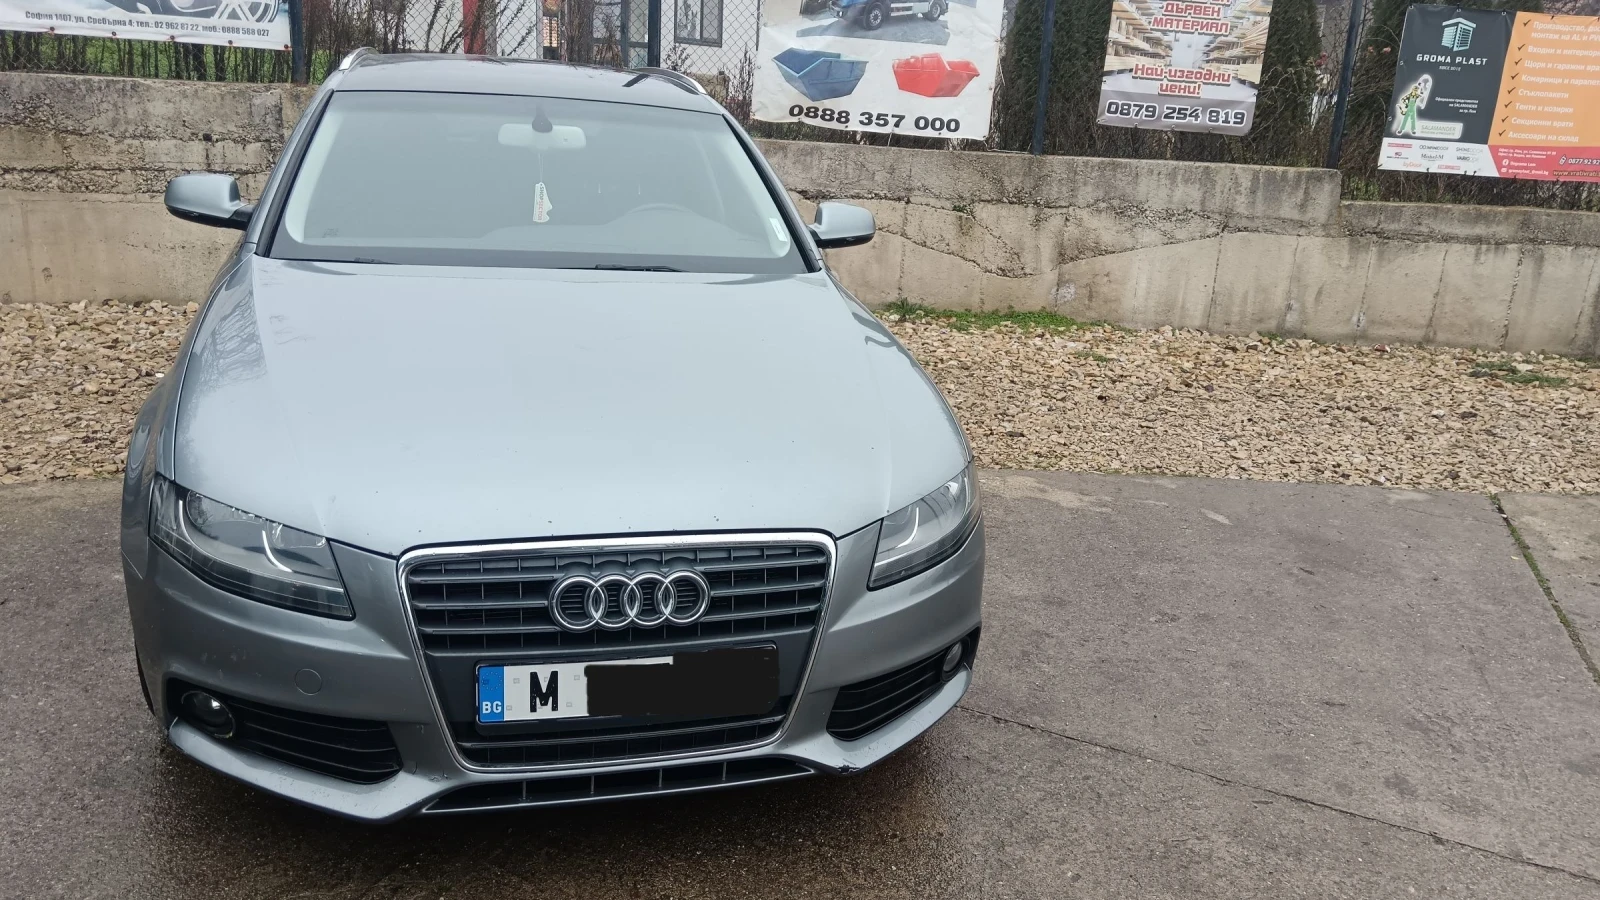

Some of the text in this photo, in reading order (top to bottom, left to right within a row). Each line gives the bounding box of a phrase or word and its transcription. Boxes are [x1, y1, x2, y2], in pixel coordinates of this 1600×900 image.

[1164, 2, 1221, 17] ДЪРВЕН
[25, 11, 53, 20] София
[87, 16, 126, 26] Сребърна
[165, 21, 179, 29] 962
[222, 26, 240, 34] 0888
[257, 29, 270, 37] 027
[1152, 17, 1229, 33] МАТЕРИАЛ
[1534, 21, 1586, 31] Производство,
[1528, 45, 1555, 54] Входни
[1416, 54, 1488, 65] GROMA PLAST
[1525, 60, 1546, 69] Щори
[1554, 62, 1585, 70] гаражни
[1134, 64, 1231, 82] Най-изгодни
[1521, 74, 1562, 84] Комарници
[1160, 83, 1202, 95] цени!
[1518, 89, 1569, 98] Стъклопакети
[1106, 101, 1246, 125] 0879 254 819
[1544, 105, 1574, 113] козирки
[789, 104, 960, 132] 0888 357 000
[1512, 117, 1551, 126] Секционни
[1508, 131, 1546, 139] Аксесоари
[529, 670, 559, 712] M
[482, 701, 502, 714] BG
